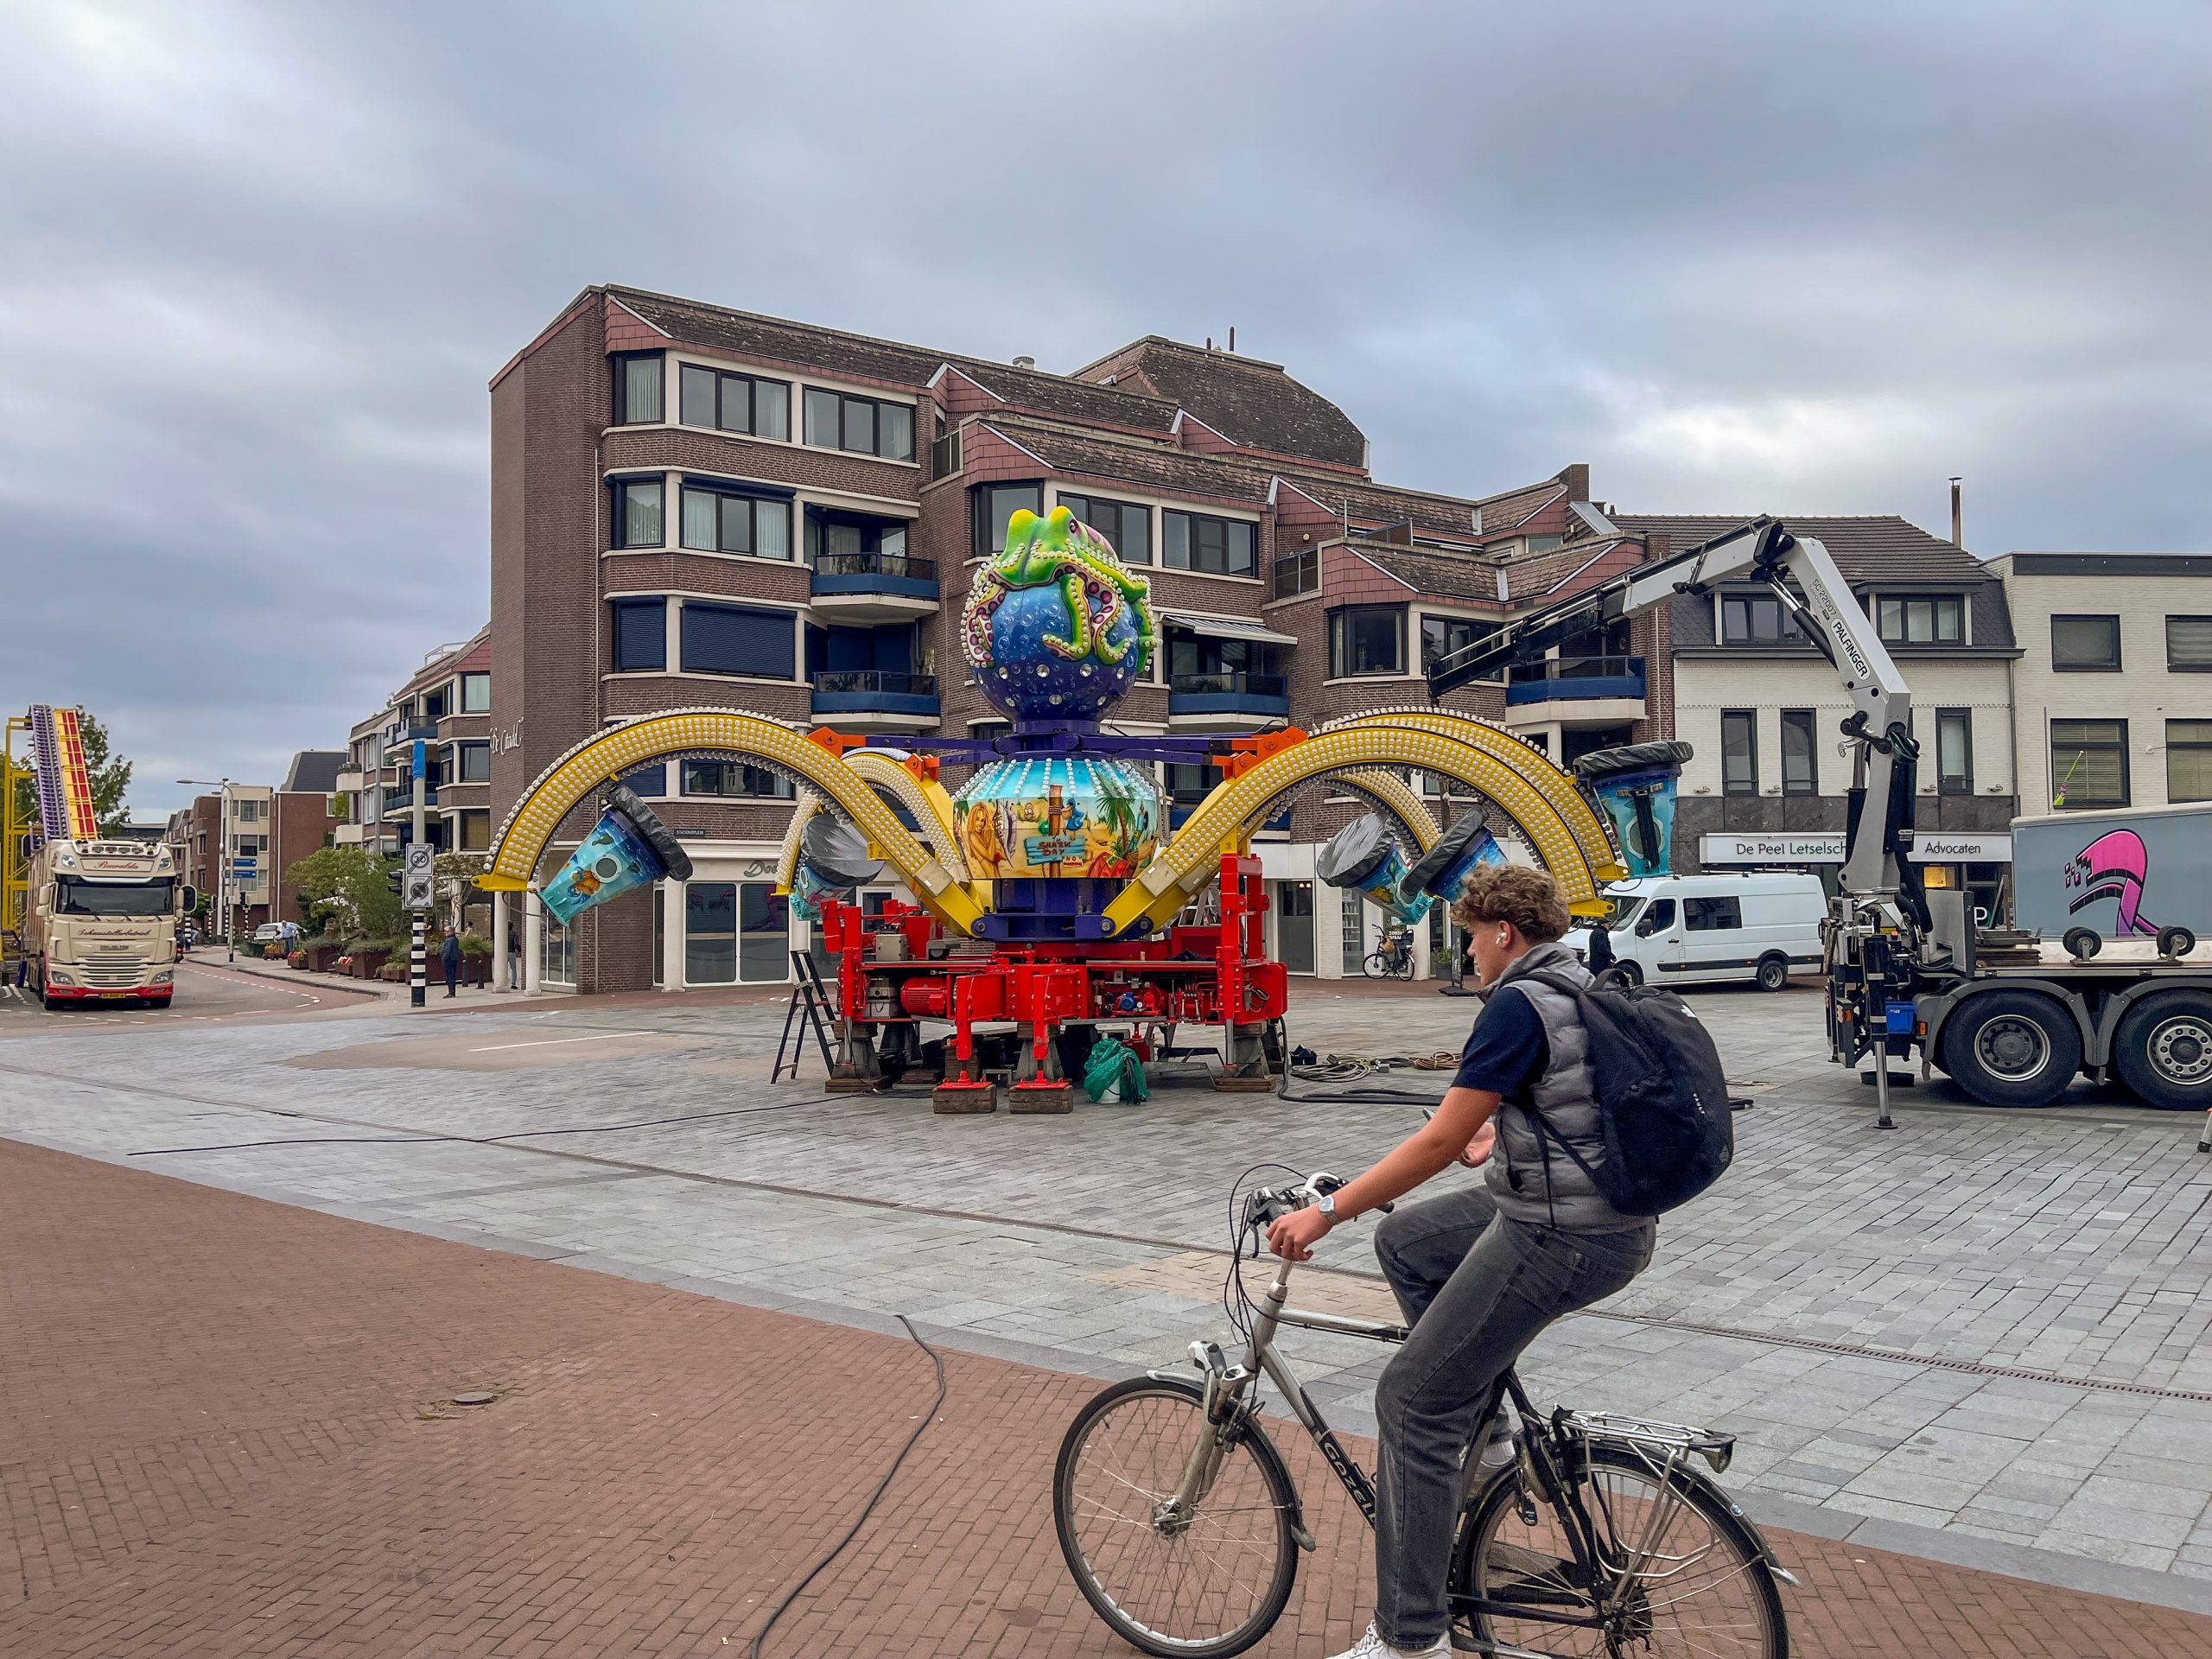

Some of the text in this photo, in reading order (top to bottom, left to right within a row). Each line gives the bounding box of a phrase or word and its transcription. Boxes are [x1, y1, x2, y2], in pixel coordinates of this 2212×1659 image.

[1812, 579, 1822, 592] SC
[1833, 621, 1868, 677] PALFINGER
[1736, 843, 1754, 855] De
[1758, 843, 1785, 855] Peel
[1925, 841, 1981, 854] Advocaten
